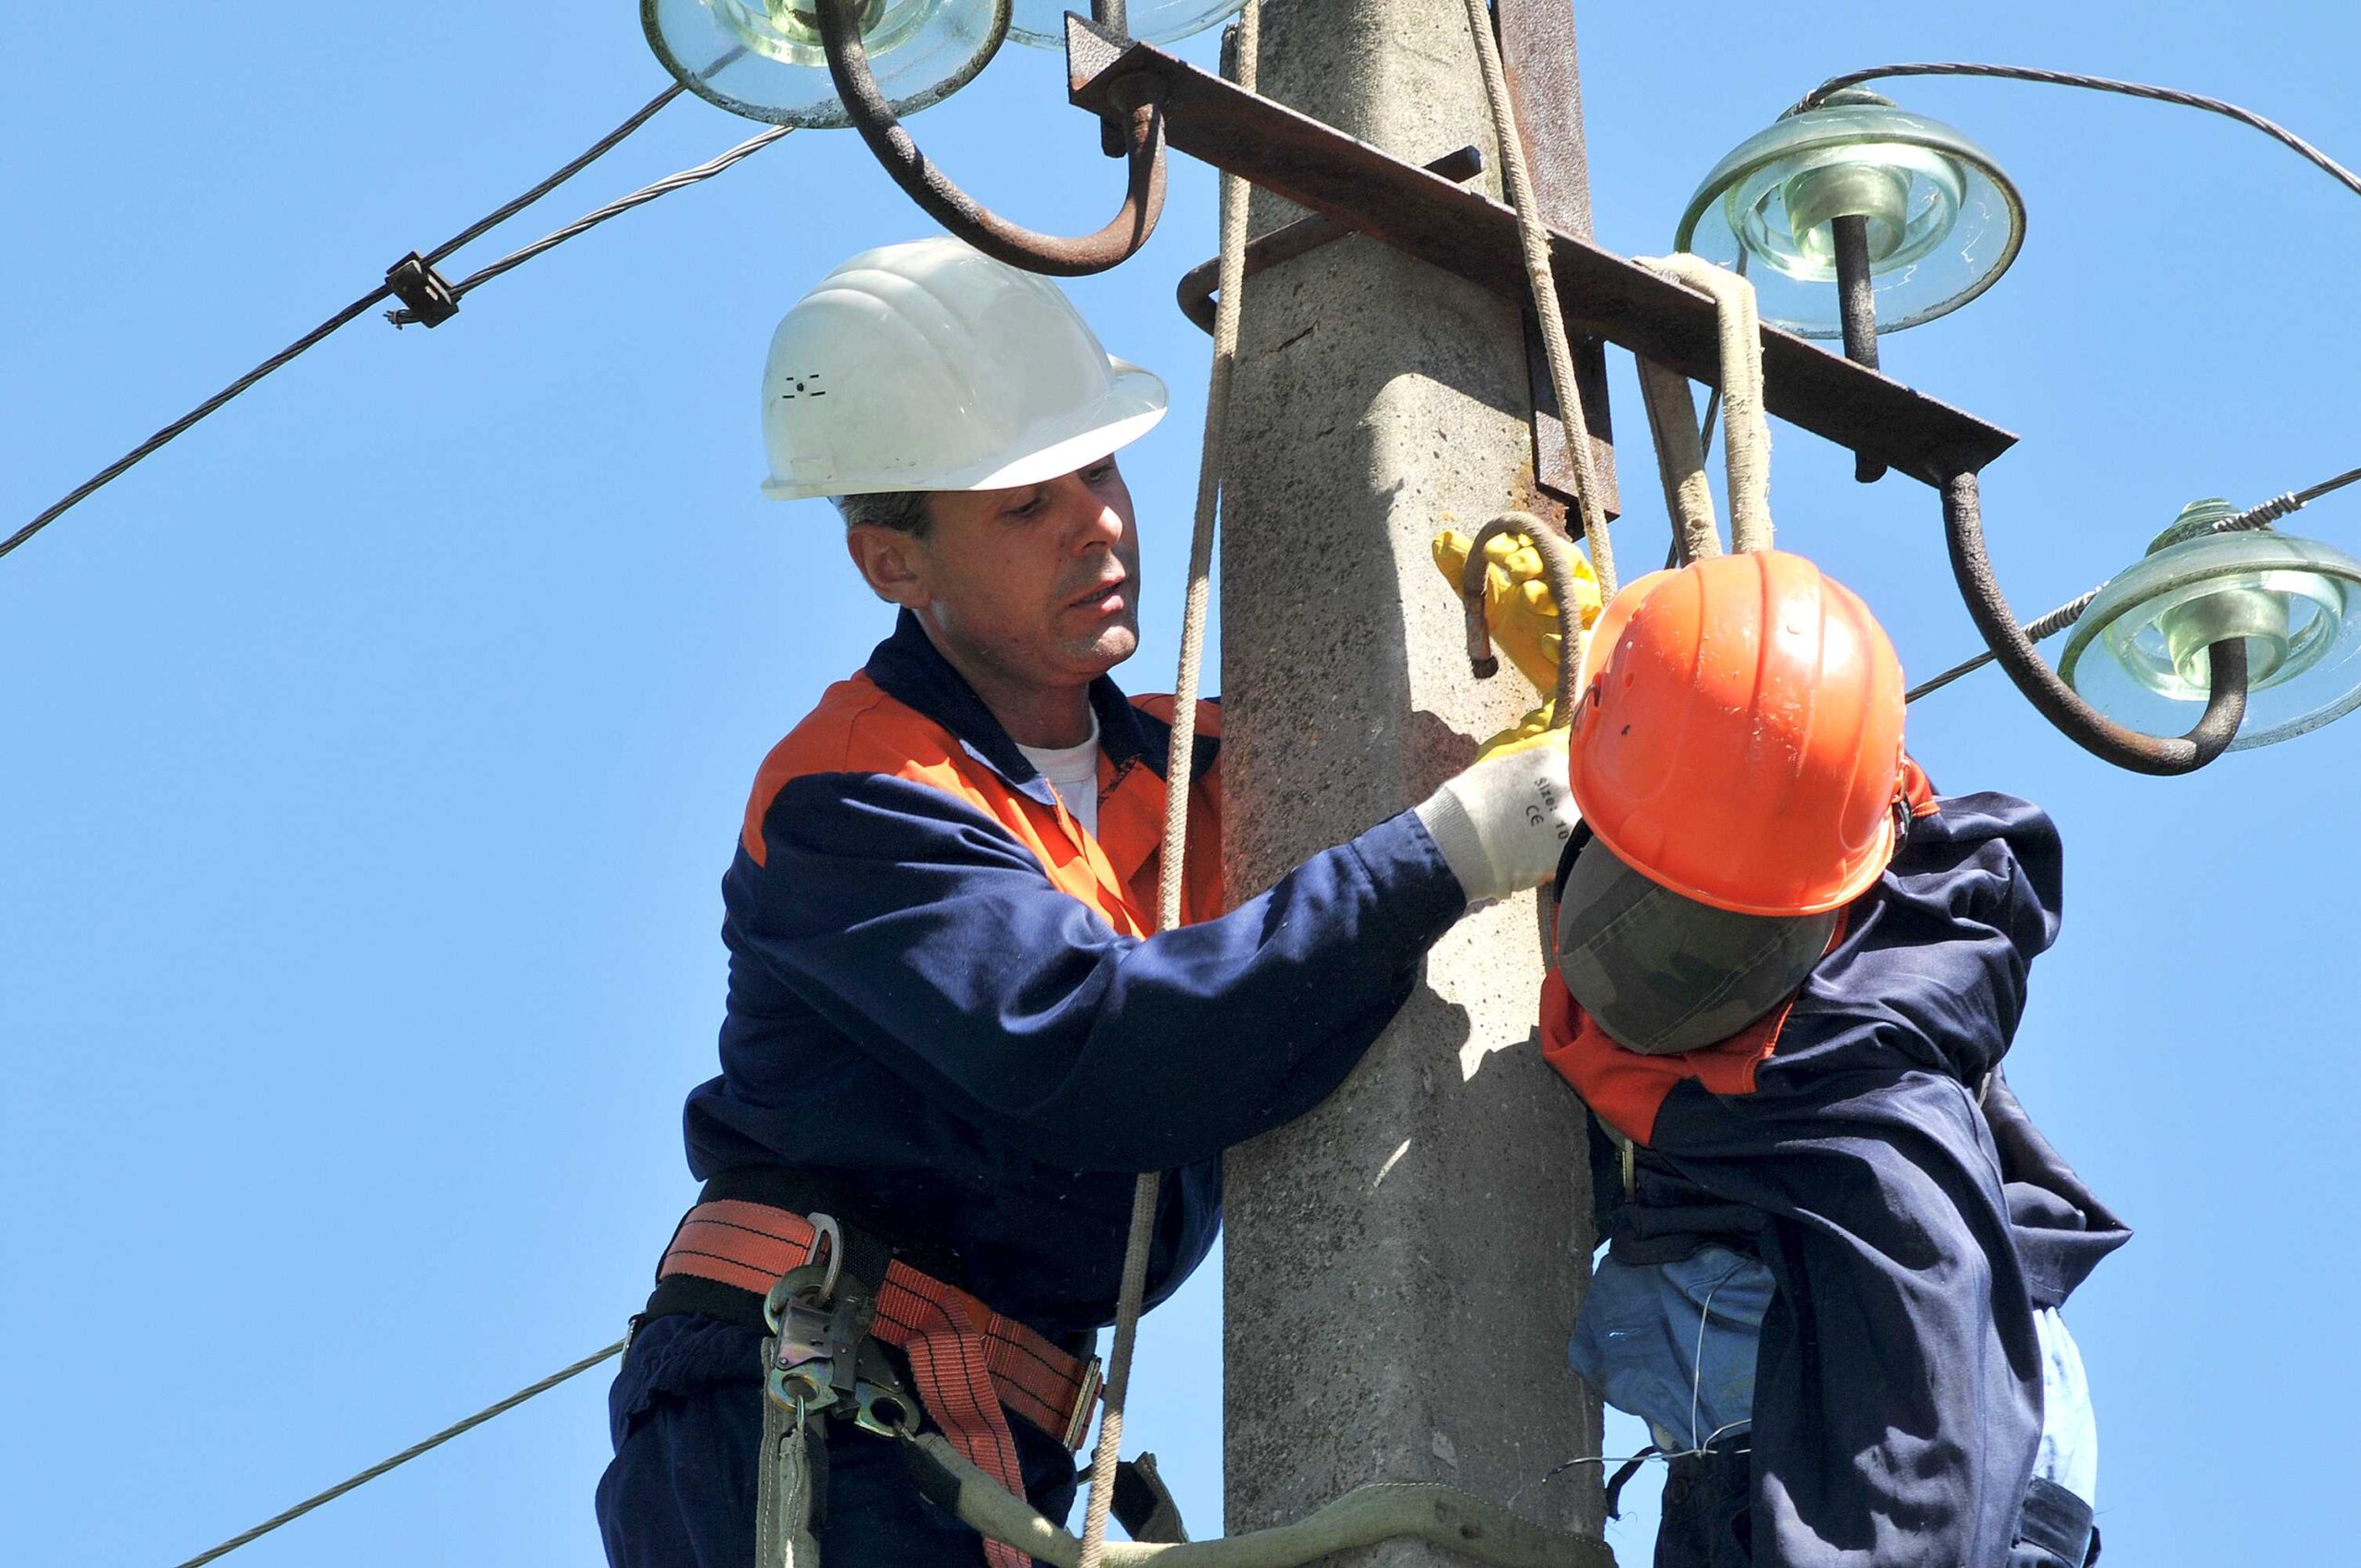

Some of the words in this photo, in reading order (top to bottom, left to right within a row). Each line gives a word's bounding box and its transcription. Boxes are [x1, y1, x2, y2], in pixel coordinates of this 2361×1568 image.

[1525, 804, 1544, 826] CE
[1535, 778, 1558, 812] Size:
[1556, 820, 1570, 839] 10
